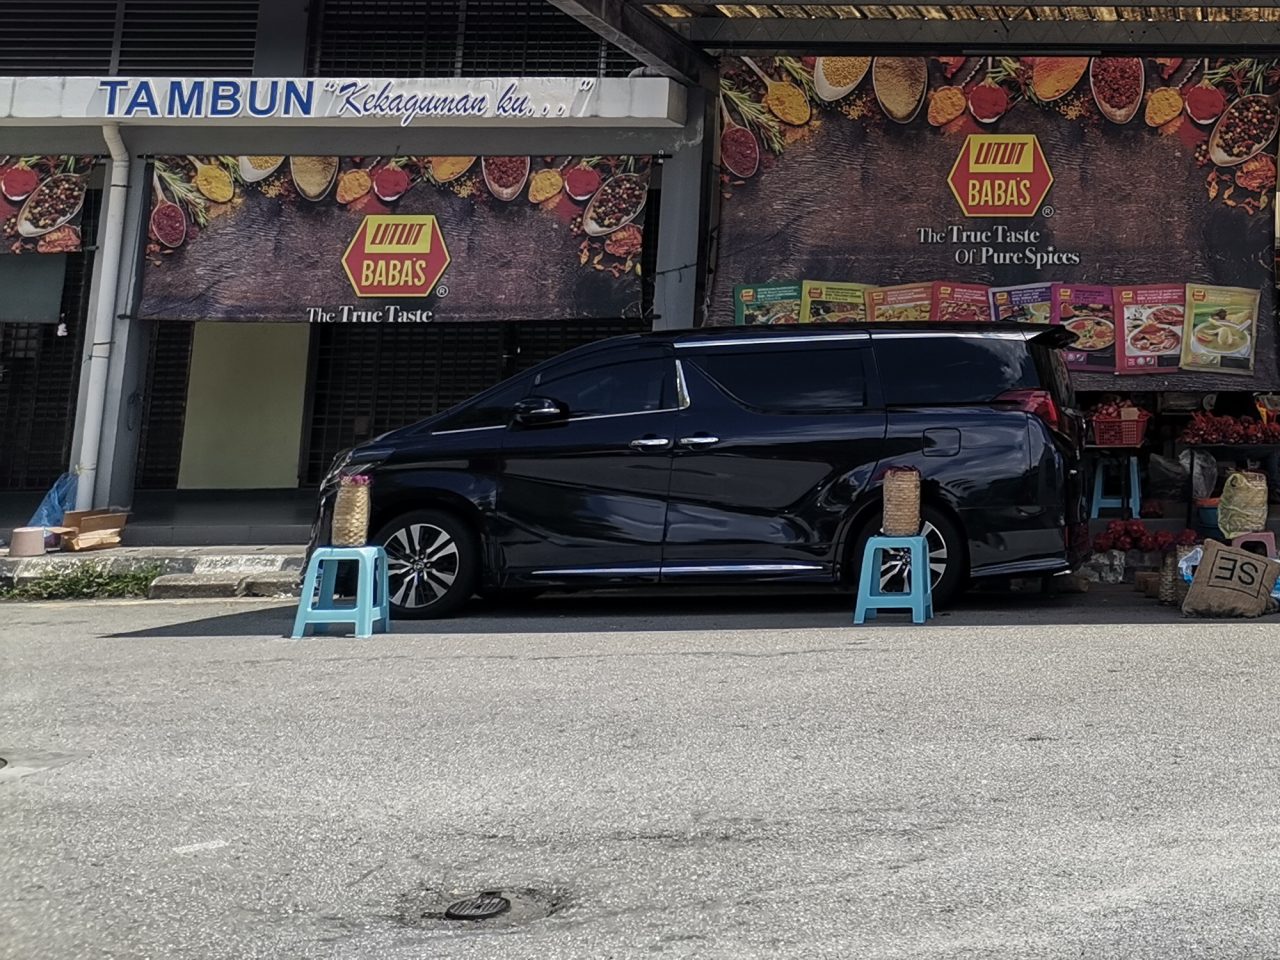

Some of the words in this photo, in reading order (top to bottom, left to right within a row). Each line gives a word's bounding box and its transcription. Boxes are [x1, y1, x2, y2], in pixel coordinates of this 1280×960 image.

[98, 79, 315, 117] TAMBUN
[917, 227, 945, 243] The
[948, 225, 991, 243] True
[993, 225, 1040, 243] Taste
[955, 248, 977, 265] Of
[980, 246, 1022, 265] Pure
[1024, 246, 1080, 270] Spices
[306, 307, 335, 323] The
[339, 305, 382, 323] True
[384, 305, 433, 323] Taste
